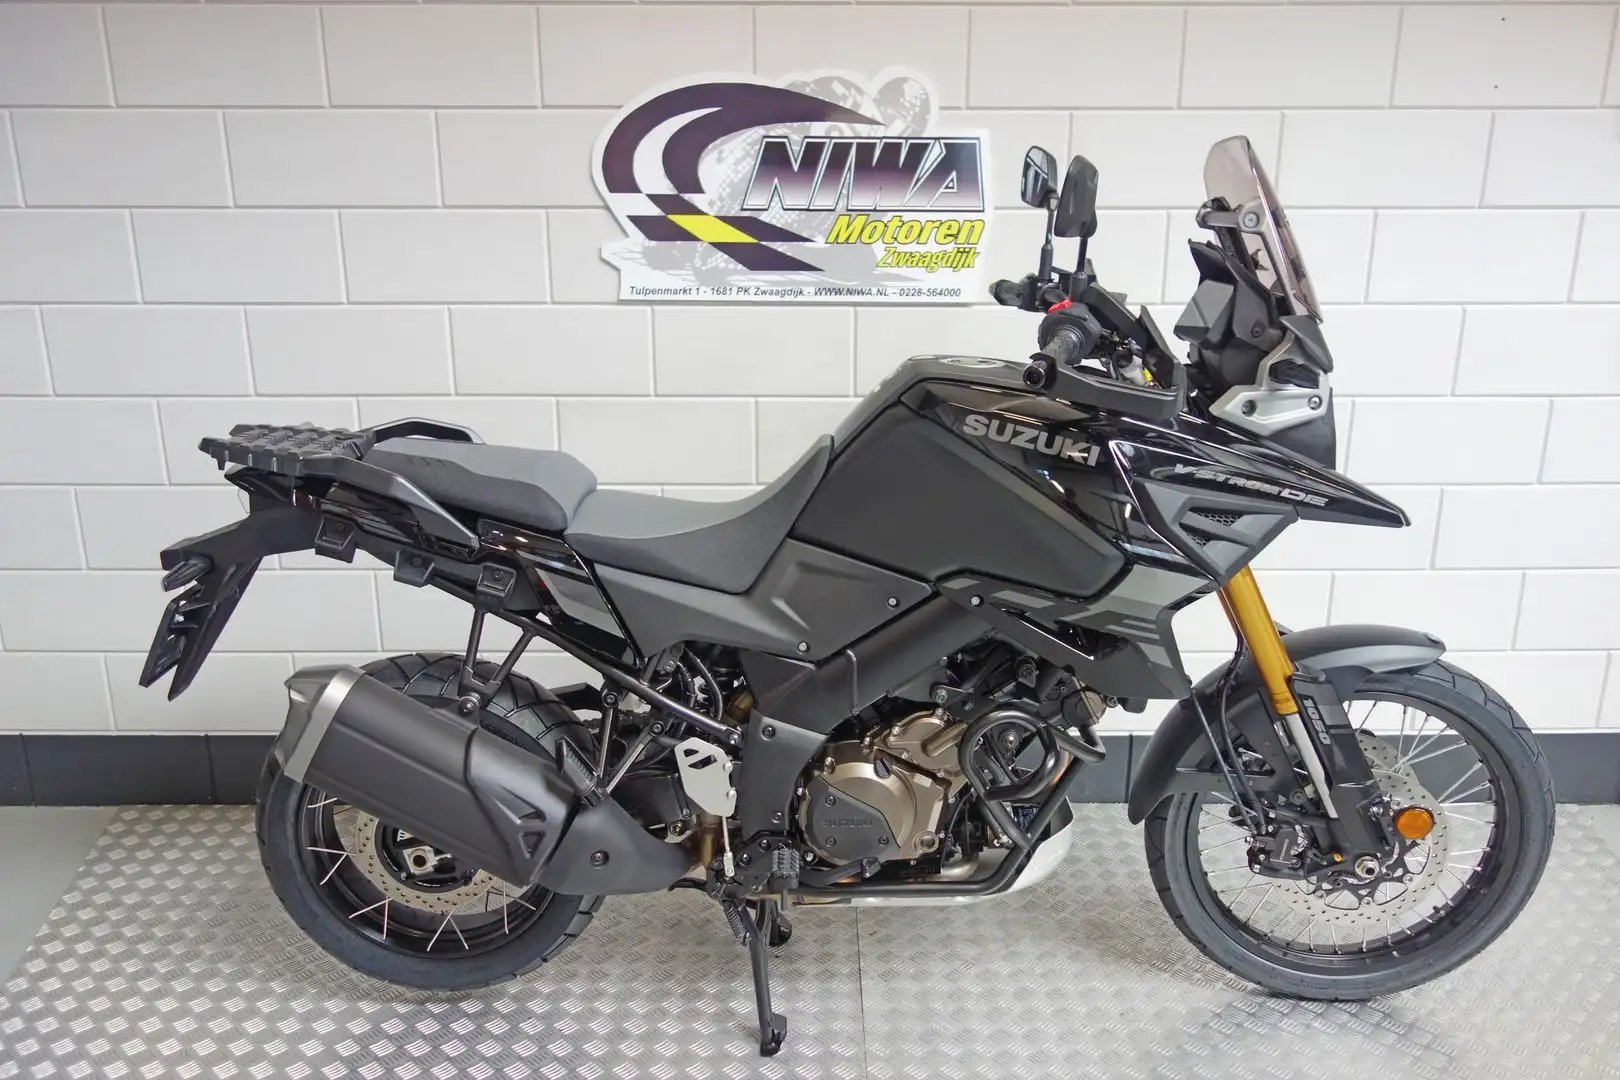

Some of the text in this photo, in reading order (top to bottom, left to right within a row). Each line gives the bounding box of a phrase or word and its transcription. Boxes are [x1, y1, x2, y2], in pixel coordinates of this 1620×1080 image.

[741, 136, 985, 212] NIWA
[825, 213, 985, 245] Motoren
[876, 247, 980, 273] Zwaagdijk
[630, 286, 692, 297] Tulpenmarkt
[695, 287, 700, 295] 1
[711, 287, 733, 296] 1681
[736, 287, 751, 296] PK
[753, 287, 805, 298] Zwaagdijk
[814, 287, 889, 297] WWW.NIWA.NL
[899, 287, 962, 297] 0228-564000
[963, 413, 1100, 467] SUZUKI
[1302, 697, 1331, 745] 1050
[822, 817, 874, 828] SUZUKI
